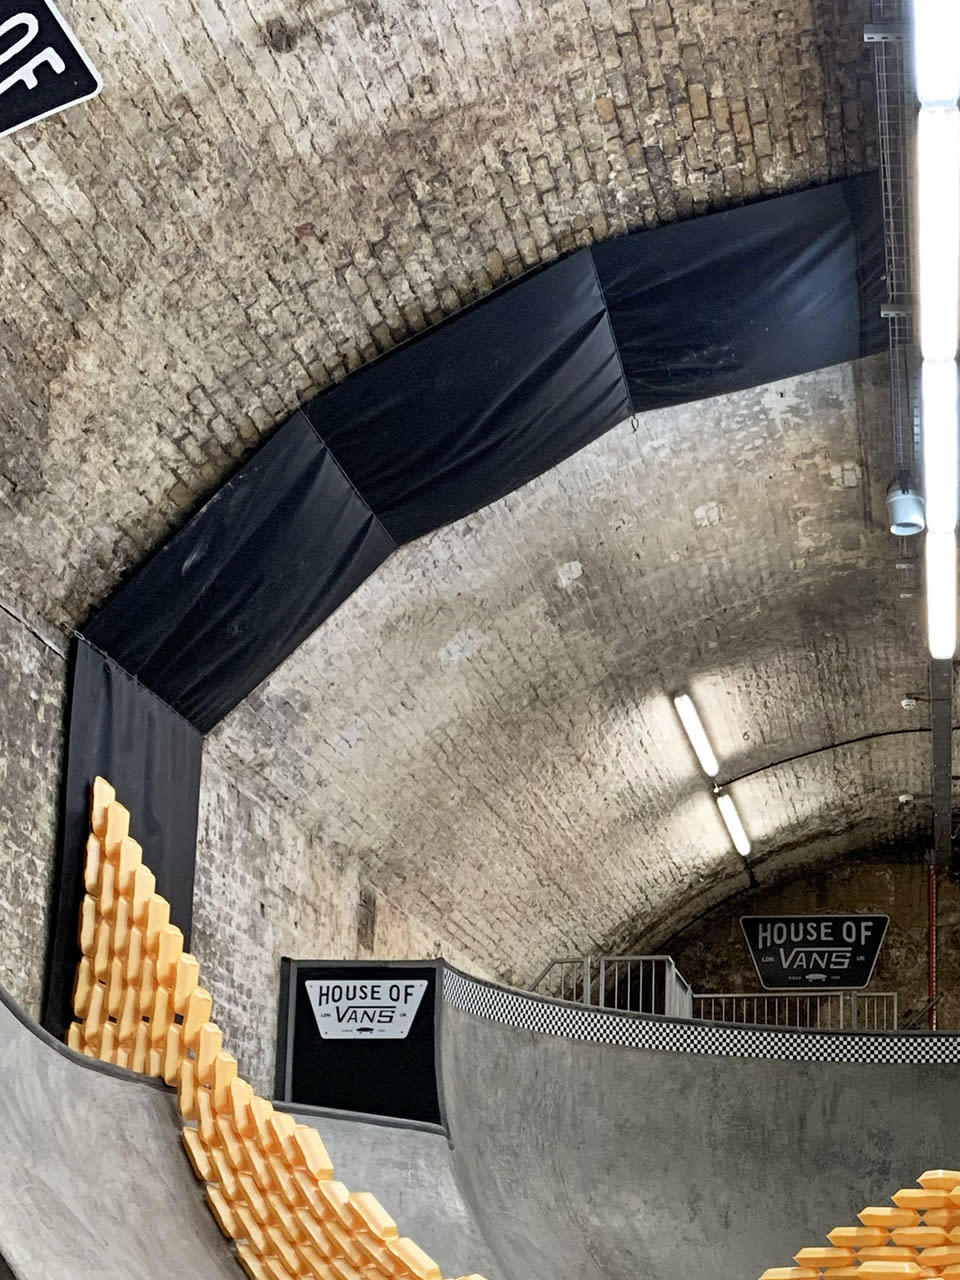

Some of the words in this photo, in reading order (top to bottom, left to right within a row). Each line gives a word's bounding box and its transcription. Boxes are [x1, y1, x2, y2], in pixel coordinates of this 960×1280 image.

[758, 922, 834, 949] HOUSE
[842, 921, 873, 946] OF
[779, 947, 853, 969] VANS
[319, 985, 381, 1006] HOUSE
[389, 984, 415, 1004] OF
[336, 1006, 396, 1023] VANS
